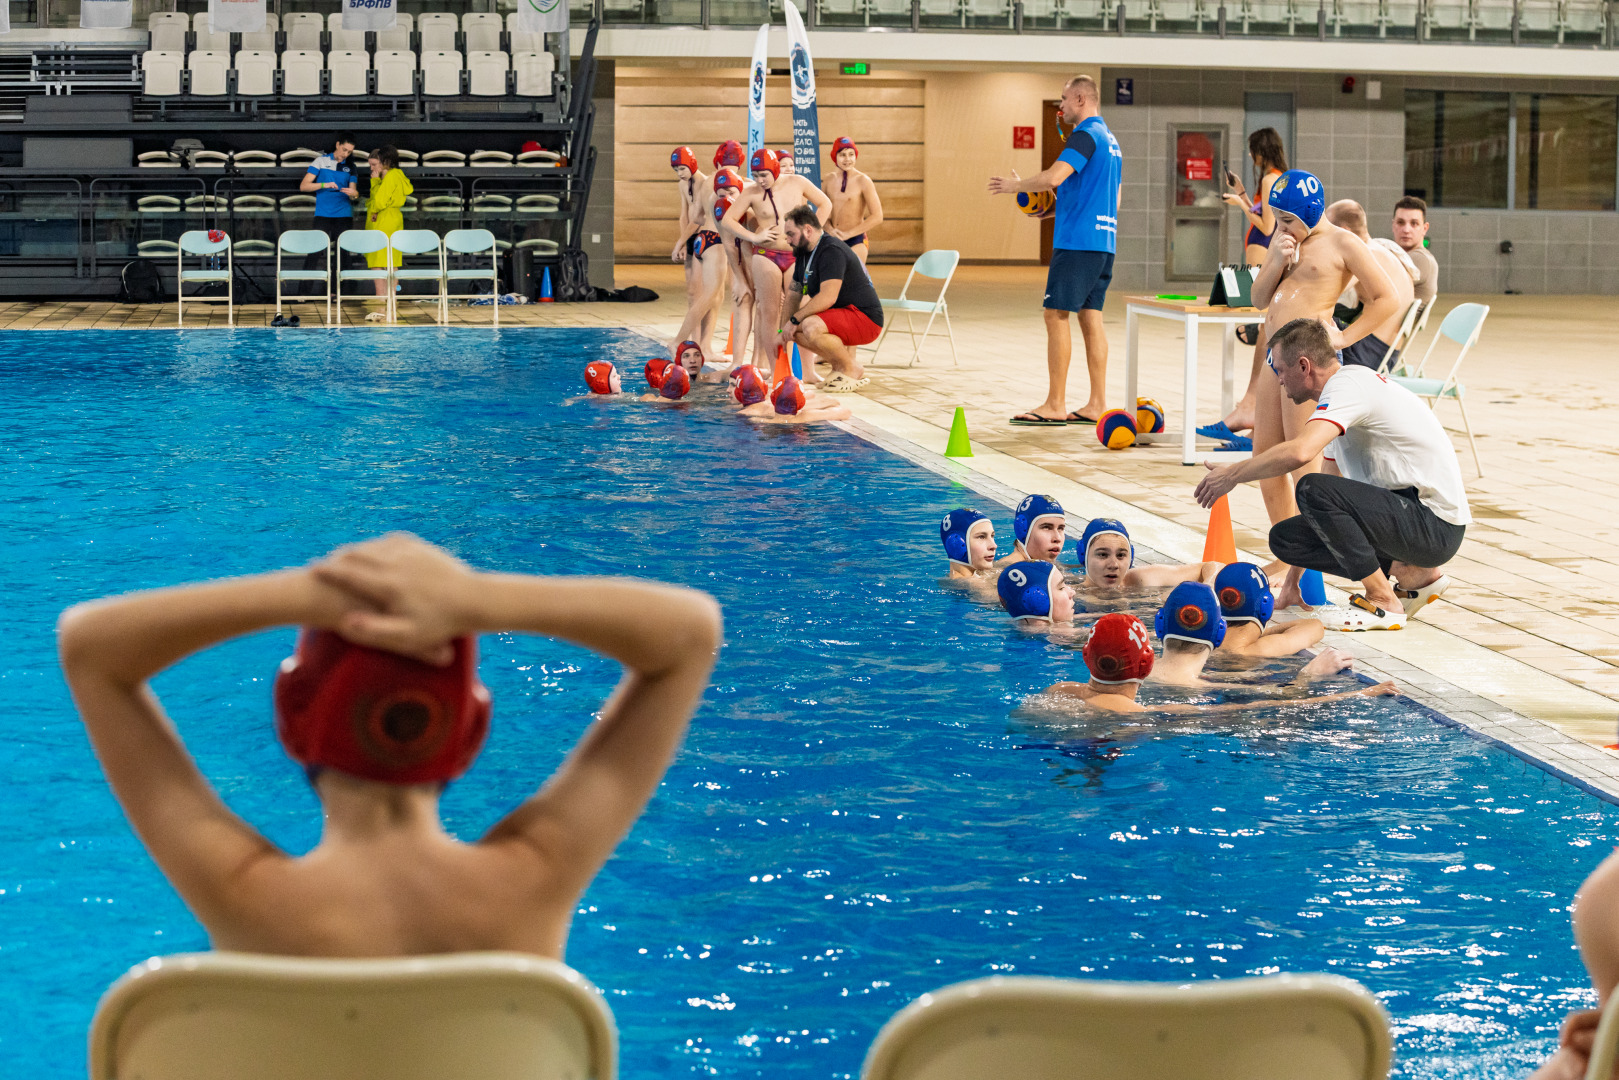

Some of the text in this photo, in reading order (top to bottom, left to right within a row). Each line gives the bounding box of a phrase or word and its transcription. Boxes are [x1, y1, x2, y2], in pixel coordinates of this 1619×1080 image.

[349, 0, 392, 8] БРФПВ
[1296, 177, 1319, 197] 10
[587, 367, 597, 378] 8
[1017, 496, 1034, 513] 13
[942, 514, 952, 532] 8
[1008, 568, 1027, 587] 9
[1250, 564, 1269, 588] 11
[1128, 621, 1147, 650] 13
